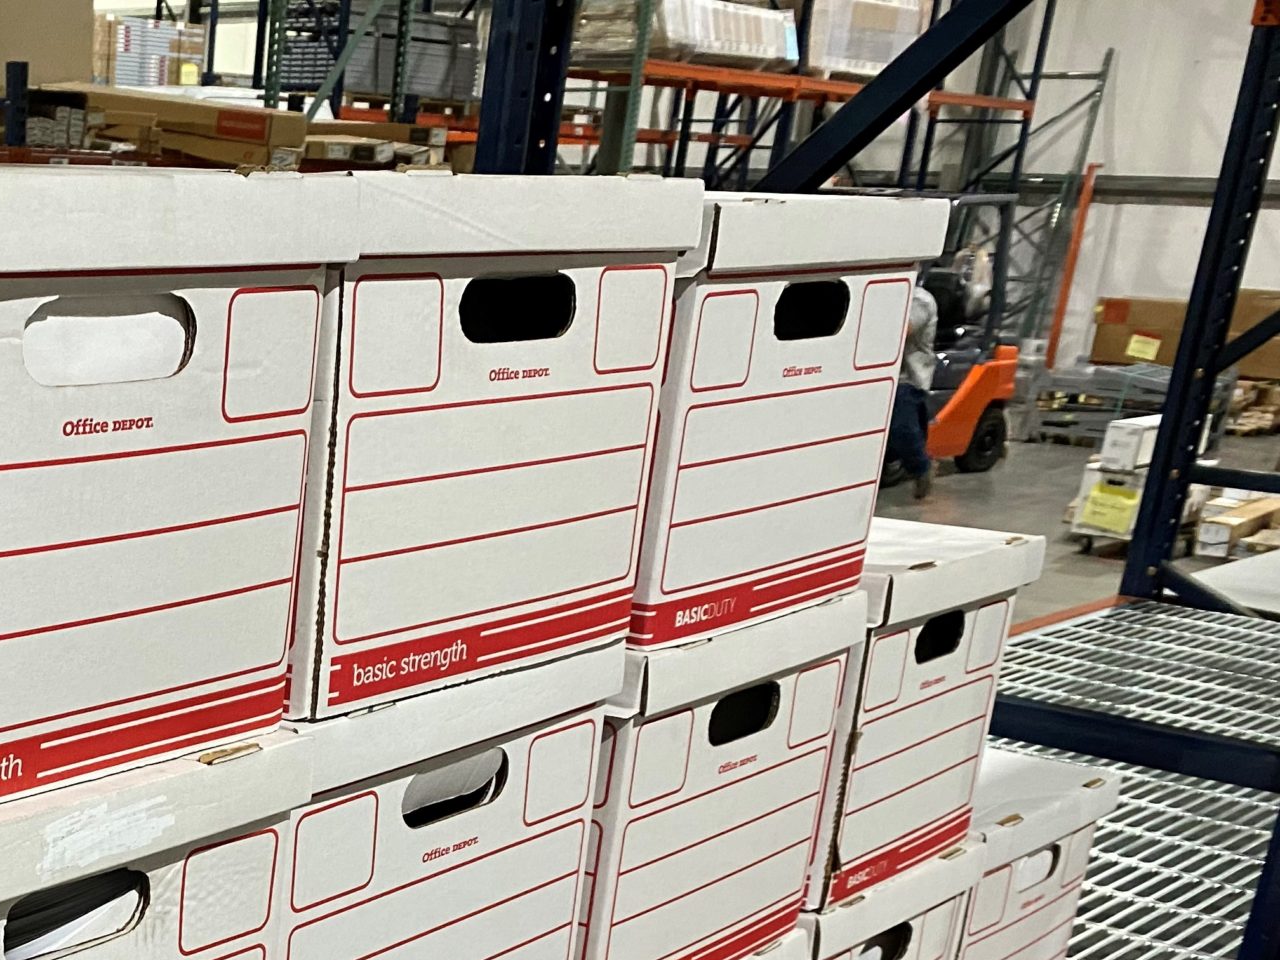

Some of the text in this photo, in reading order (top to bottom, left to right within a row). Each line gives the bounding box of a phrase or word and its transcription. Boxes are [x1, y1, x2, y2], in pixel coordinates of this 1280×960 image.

[488, 367, 520, 382] Office
[62, 418, 109, 437] Office
[674, 597, 737, 628] BASICDUTY
[351, 639, 468, 687] basic strength
[422, 846, 451, 863] Office
